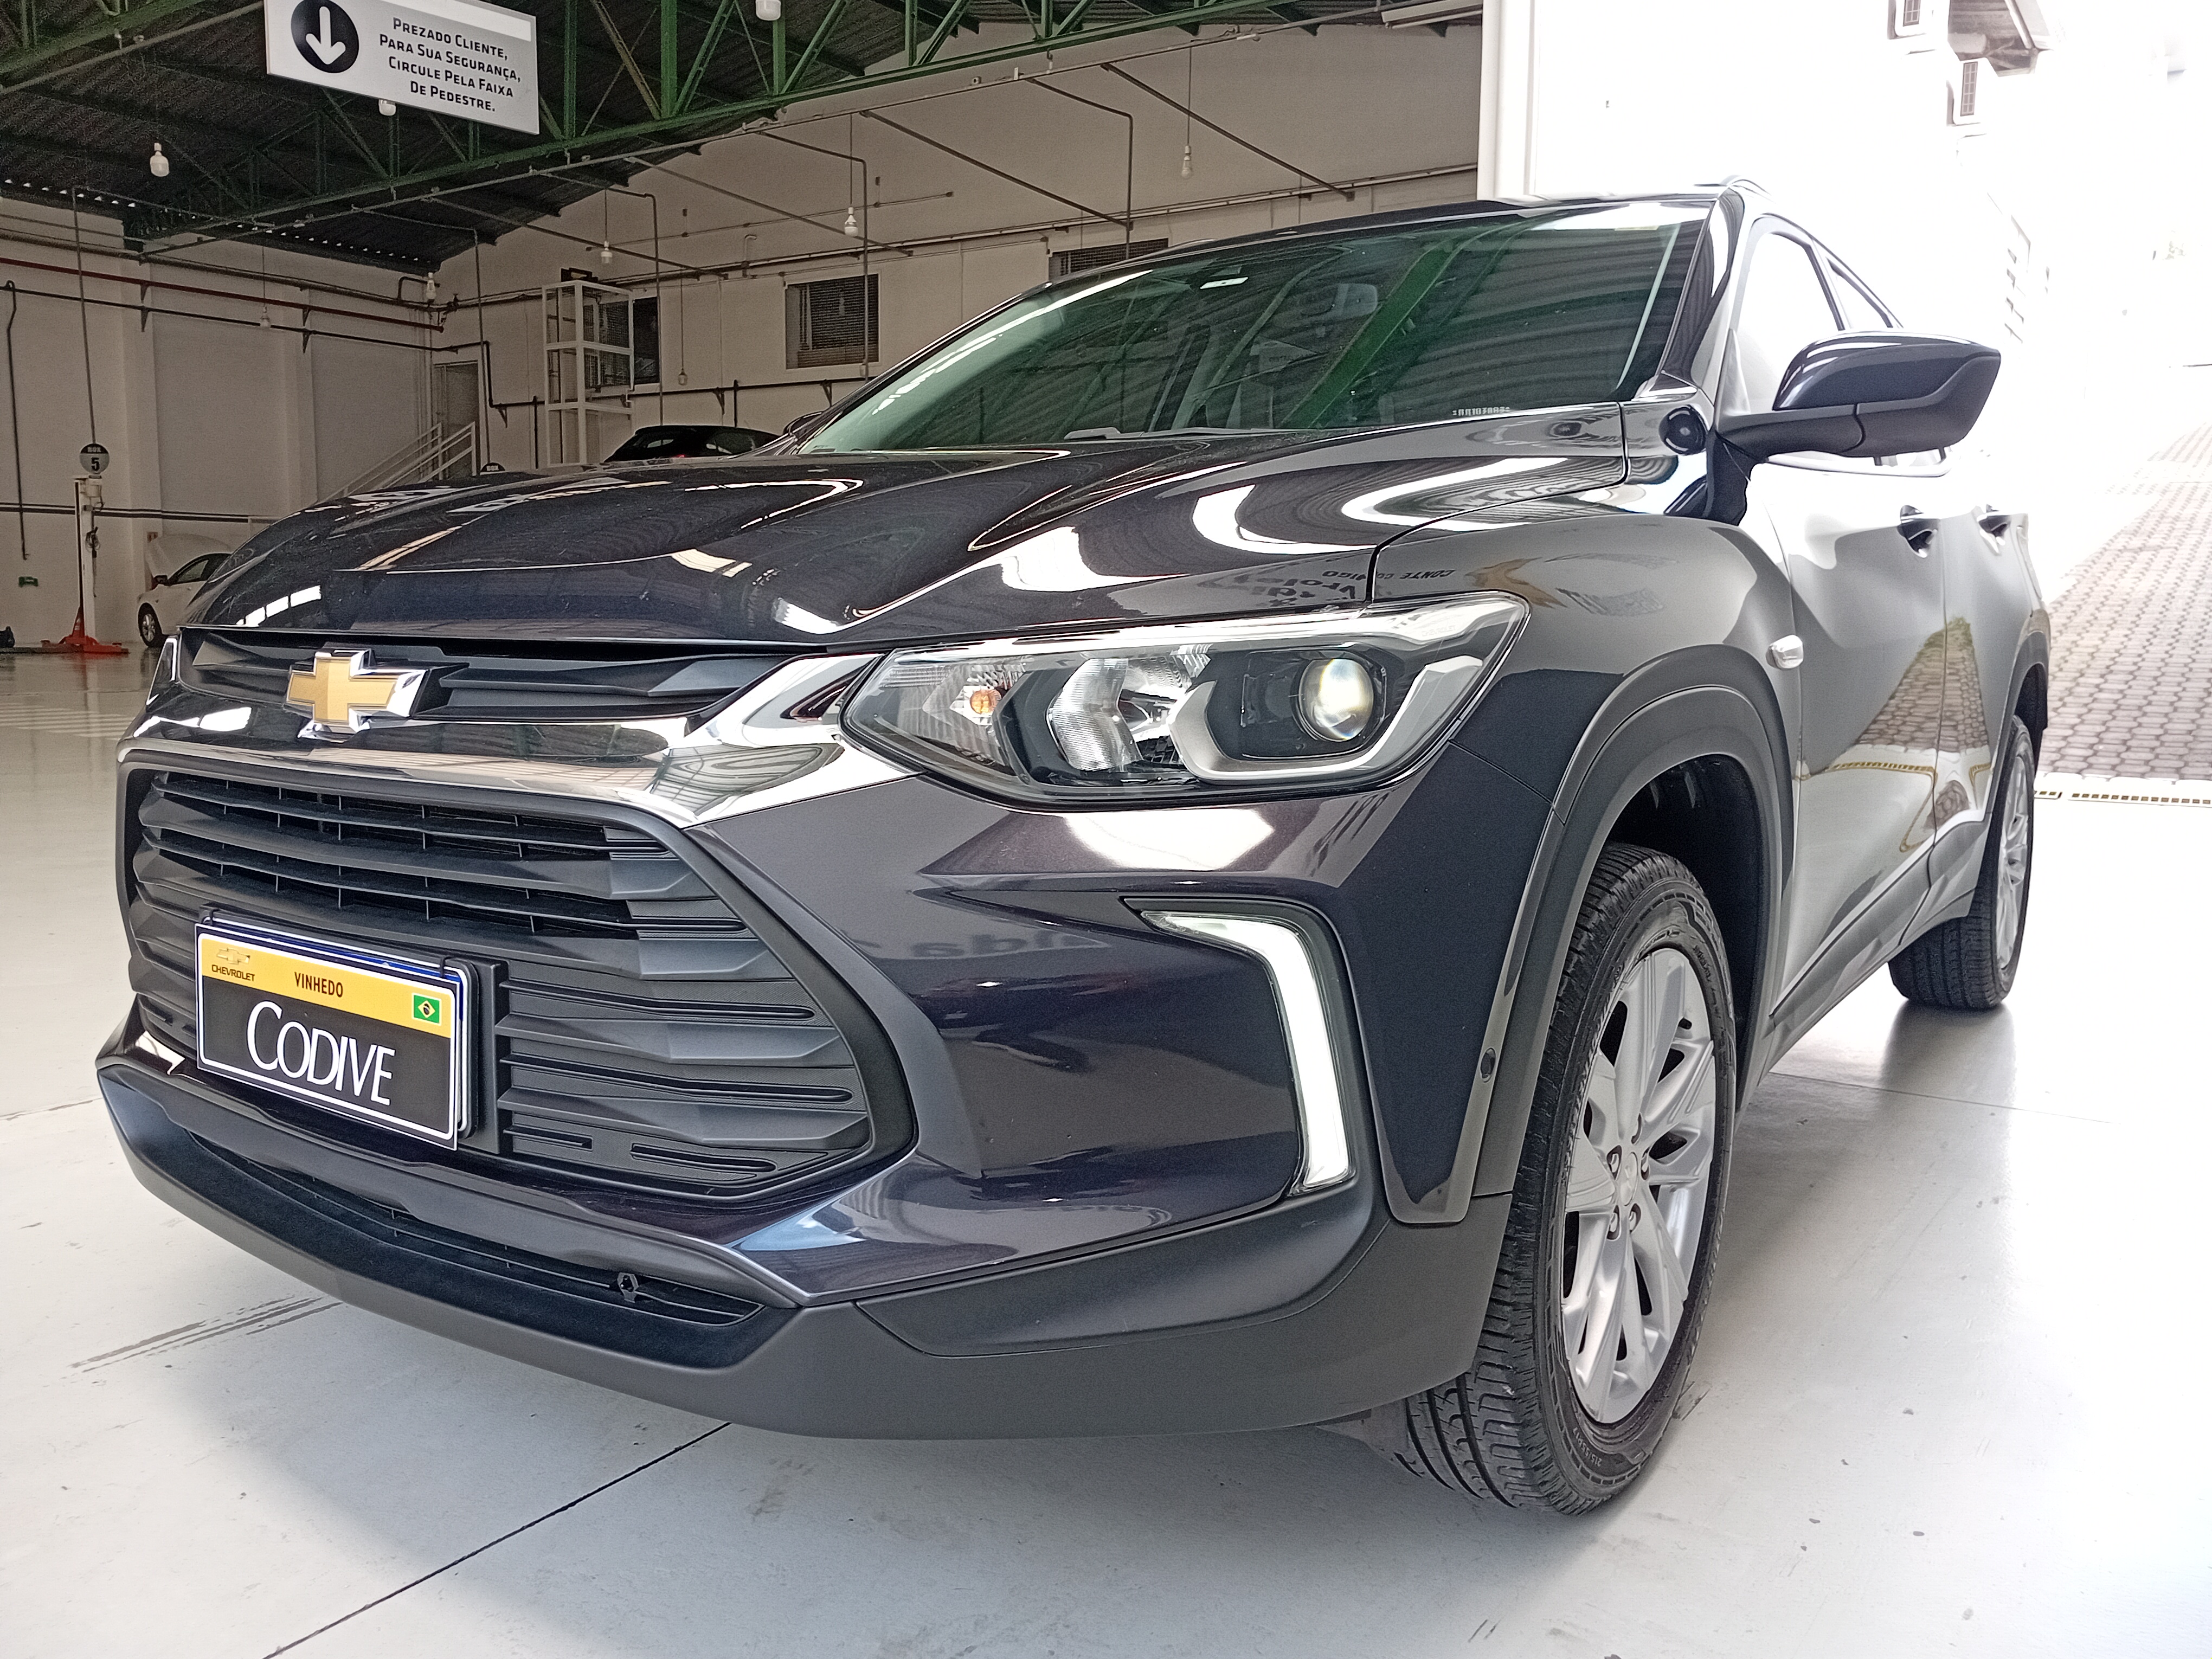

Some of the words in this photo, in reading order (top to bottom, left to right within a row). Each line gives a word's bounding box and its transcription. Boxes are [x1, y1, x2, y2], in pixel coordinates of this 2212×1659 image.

[380, 34, 414, 53] PARA
[417, 44, 442, 61] SUA
[393, 17, 451, 43] PREZADO
[455, 35, 508, 61] CLIENTE,
[389, 56, 440, 80] CIRCULE
[445, 69, 475, 88] PELA
[479, 78, 513, 97] FAIXA
[410, 80, 426, 95] DE
[430, 86, 495, 112] PEDESTRE.
[91, 457, 100, 471] 5
[211, 964, 255, 982] CHEVROLET
[294, 972, 344, 998] VINHEDO
[247, 1001, 395, 1106] CODIVE
